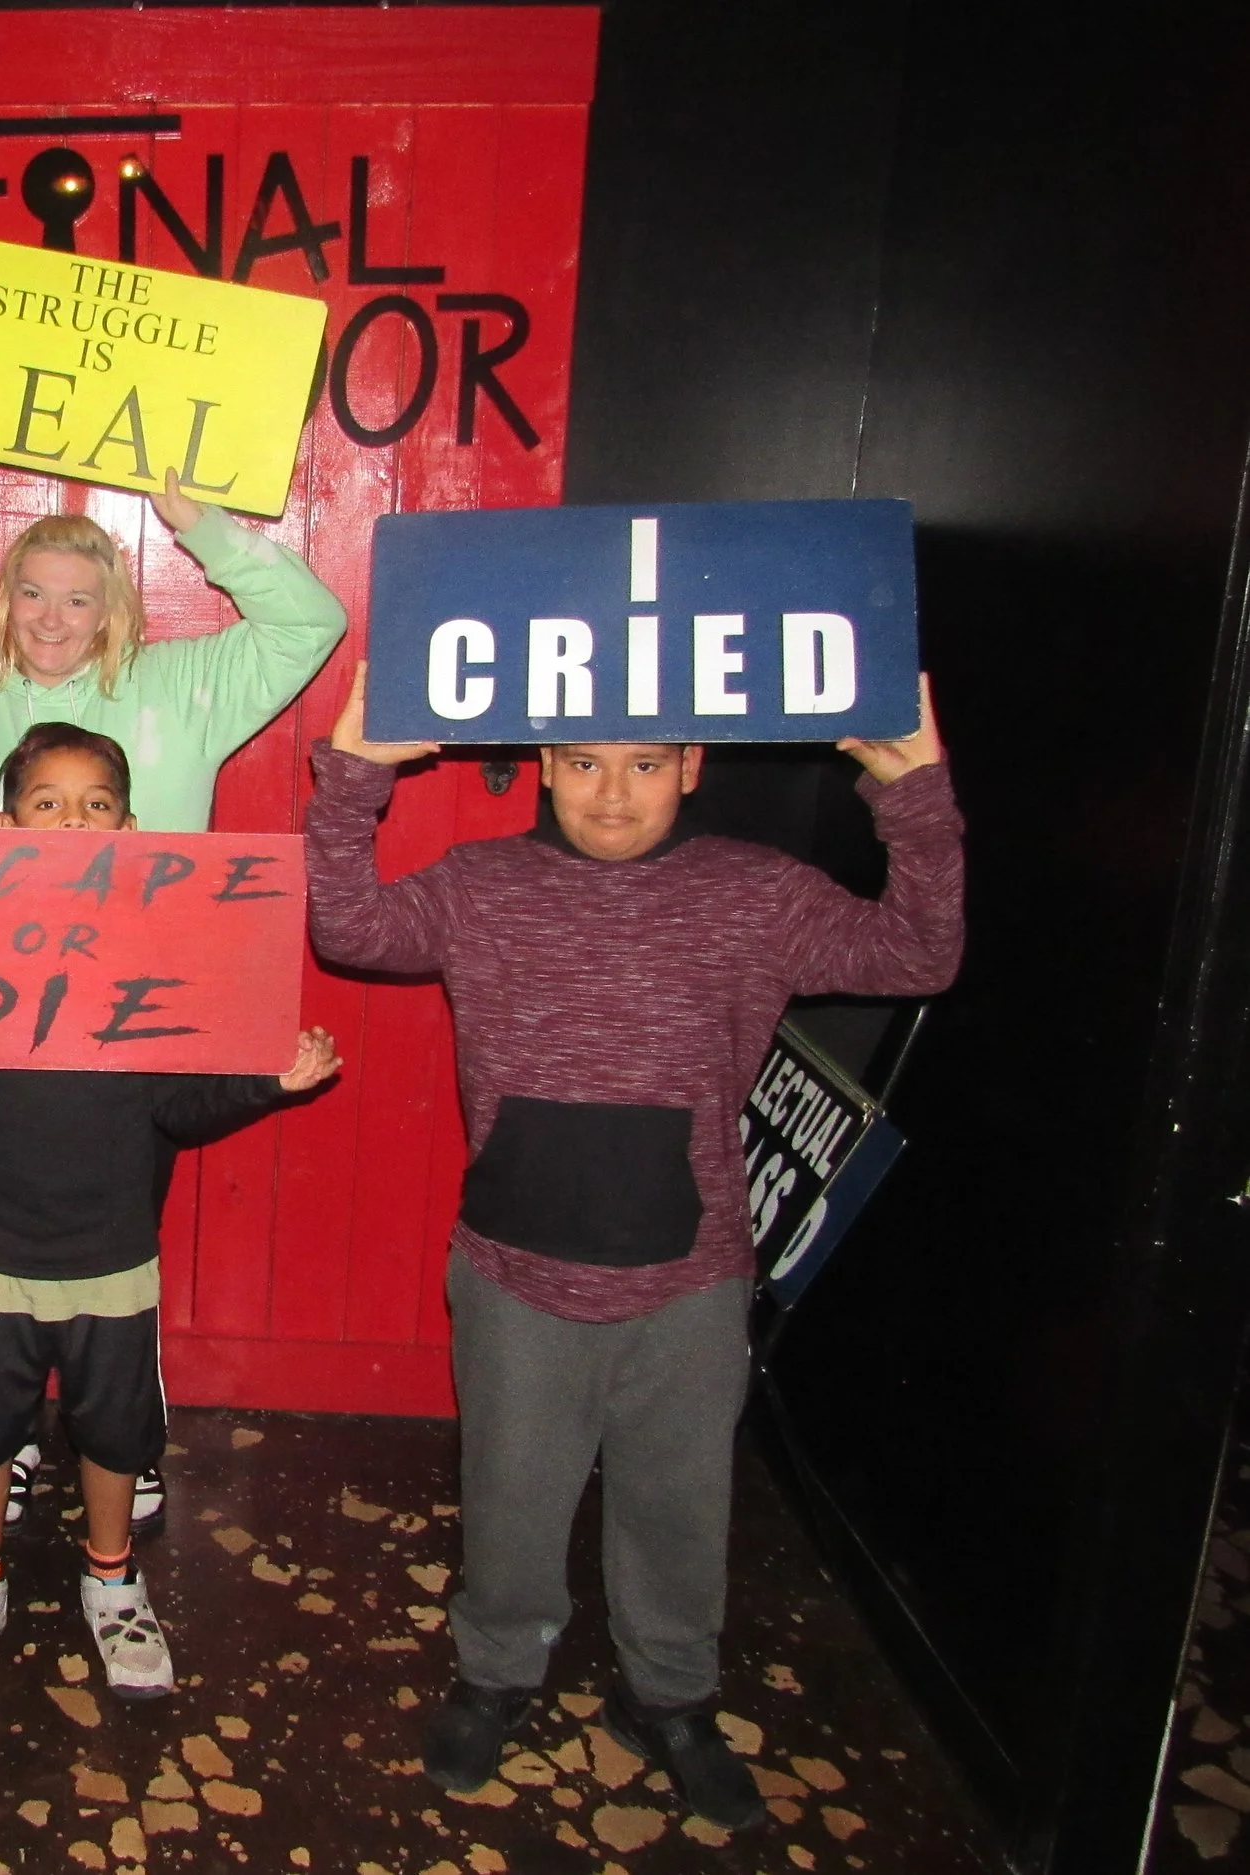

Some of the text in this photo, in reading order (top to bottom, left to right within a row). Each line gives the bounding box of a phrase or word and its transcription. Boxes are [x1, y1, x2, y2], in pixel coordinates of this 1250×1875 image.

[70, 262, 153, 306] THE
[79, 339, 114, 373] IS
[303, 292, 541, 452] OR
[630, 518, 658, 602] I
[427, 613, 857, 720] CRIED
[11, 921, 99, 960] OR
